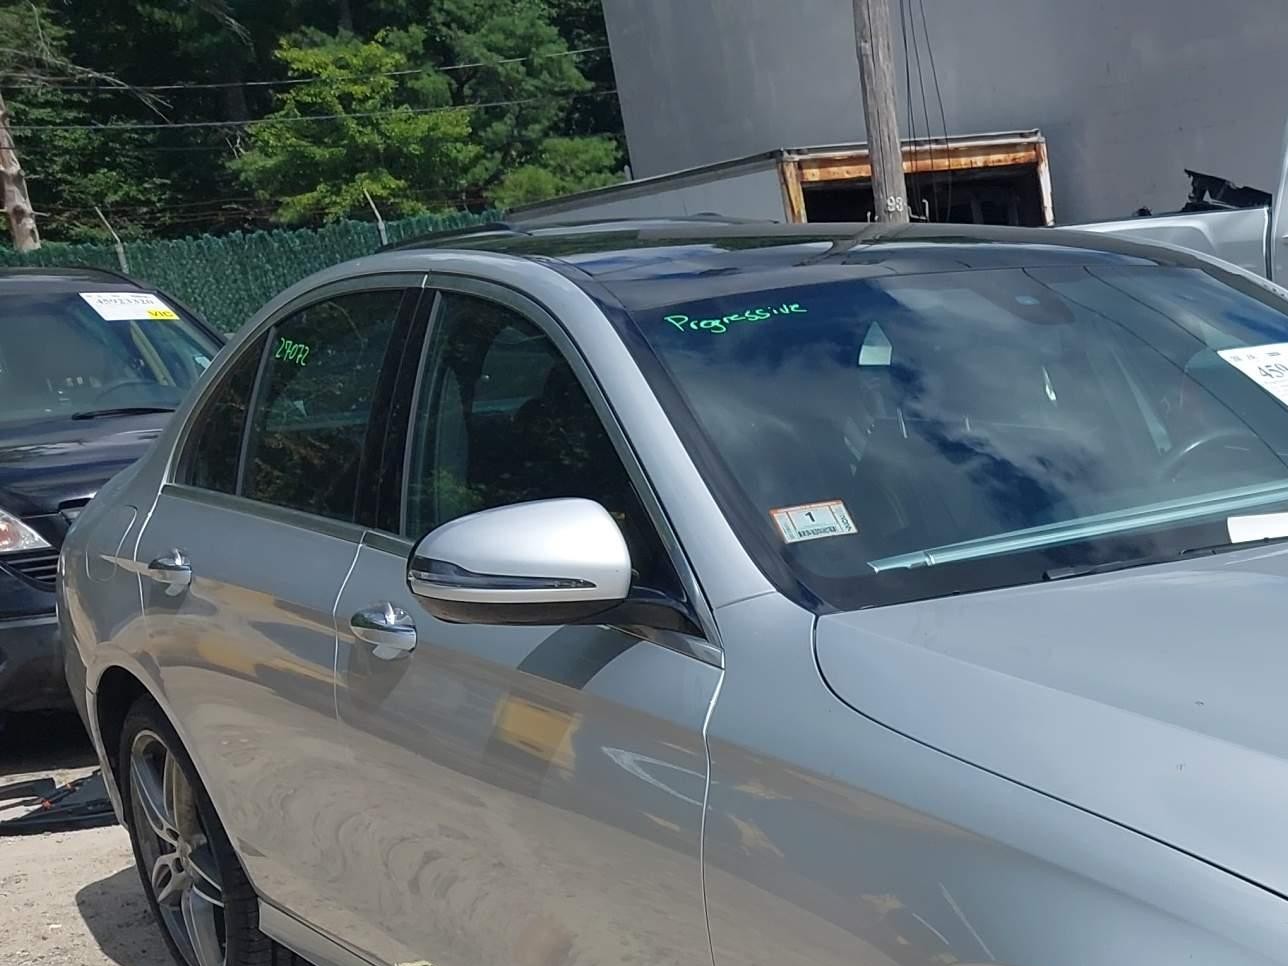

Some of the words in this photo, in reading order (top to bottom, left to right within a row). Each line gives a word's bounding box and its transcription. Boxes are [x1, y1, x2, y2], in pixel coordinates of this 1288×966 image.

[887, 195, 904, 212] 93
[664, 303, 808, 333] Progressive
[276, 337, 310, 366] 27072
[804, 511, 816, 523] 1
